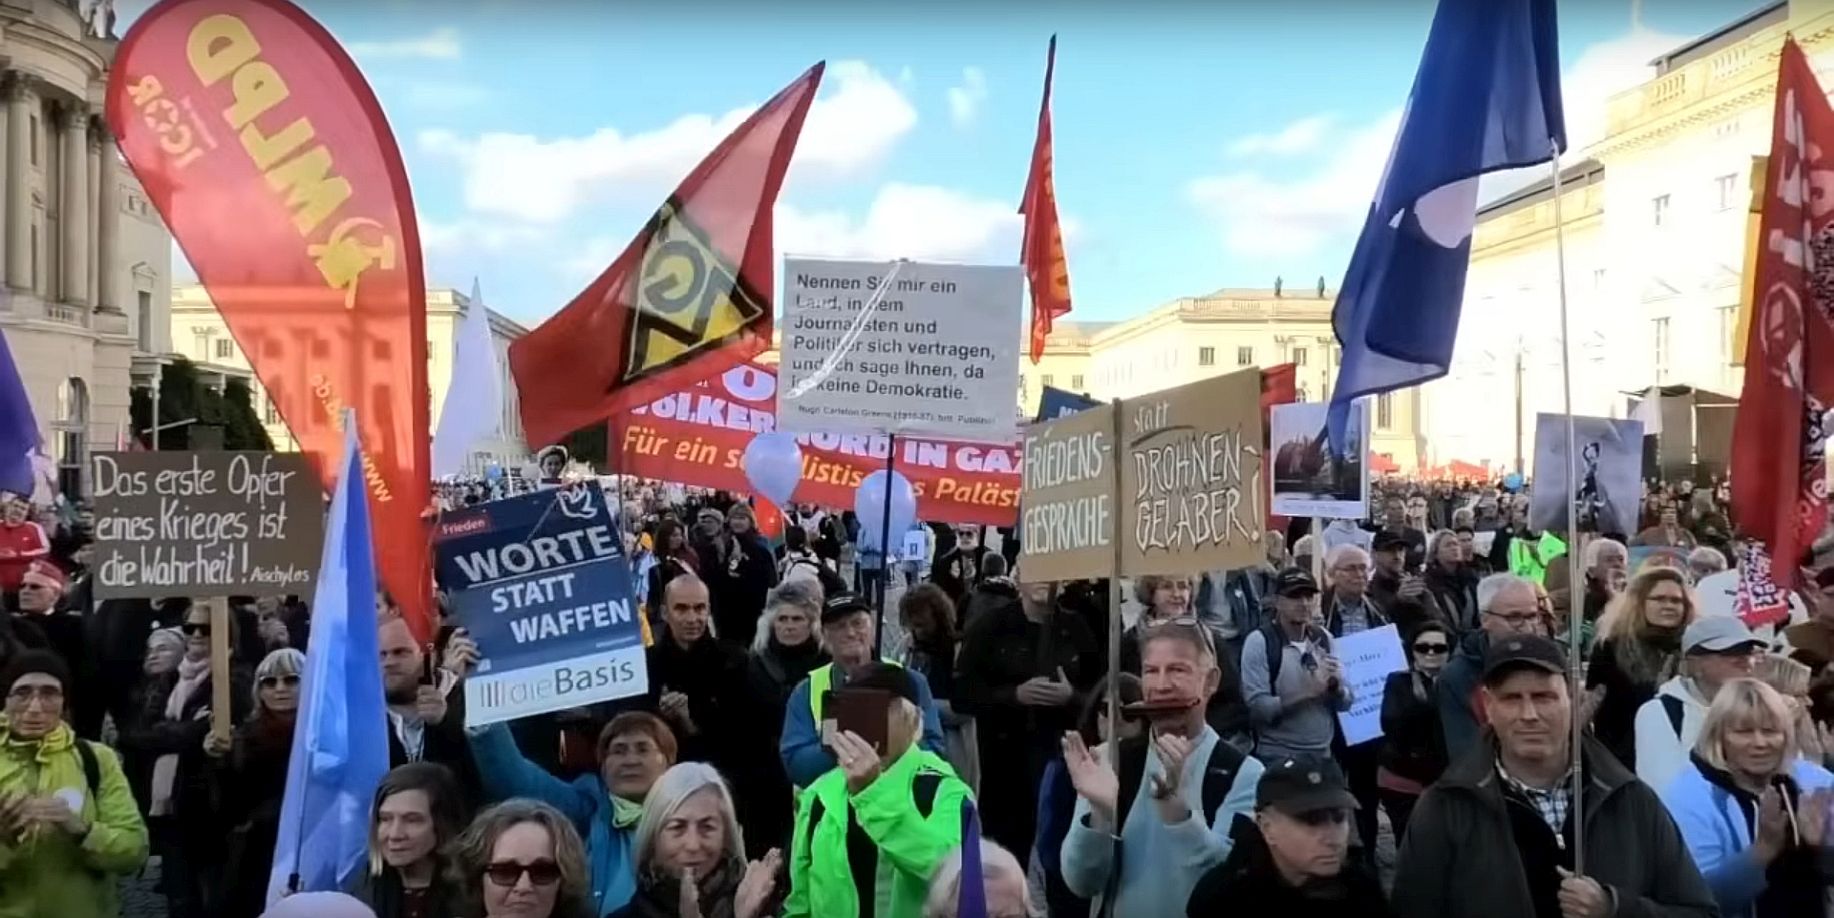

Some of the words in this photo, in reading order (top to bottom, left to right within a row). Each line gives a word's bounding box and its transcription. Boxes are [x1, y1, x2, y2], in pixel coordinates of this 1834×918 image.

[797, 273, 861, 290] Nennen
[897, 279, 926, 292] mir
[930, 279, 957, 293] ein
[847, 297, 862, 310] in
[903, 319, 938, 334] und
[867, 338, 903, 353] sich
[907, 341, 996, 361] vertragen,
[859, 361, 900, 377] sage
[904, 360, 958, 380] Ihnen,
[963, 364, 984, 379] da
[865, 379, 969, 400] Demokratie.
[622, 425, 669, 457] Für
[674, 437, 719, 466] ein
[903, 440, 948, 469] IN
[1024, 427, 1112, 493] FRIEDENS-
[93, 454, 148, 497] Das
[154, 453, 217, 496] erste
[227, 453, 297, 504] Opfer
[95, 507, 155, 541] eines
[160, 496, 249, 549] Krieges
[257, 500, 289, 540] ist
[441, 518, 487, 536] Frieden
[99, 549, 138, 587] die
[453, 525, 619, 583] WORTE
[491, 572, 576, 614] STATT
[509, 597, 632, 645] WAFFEN
